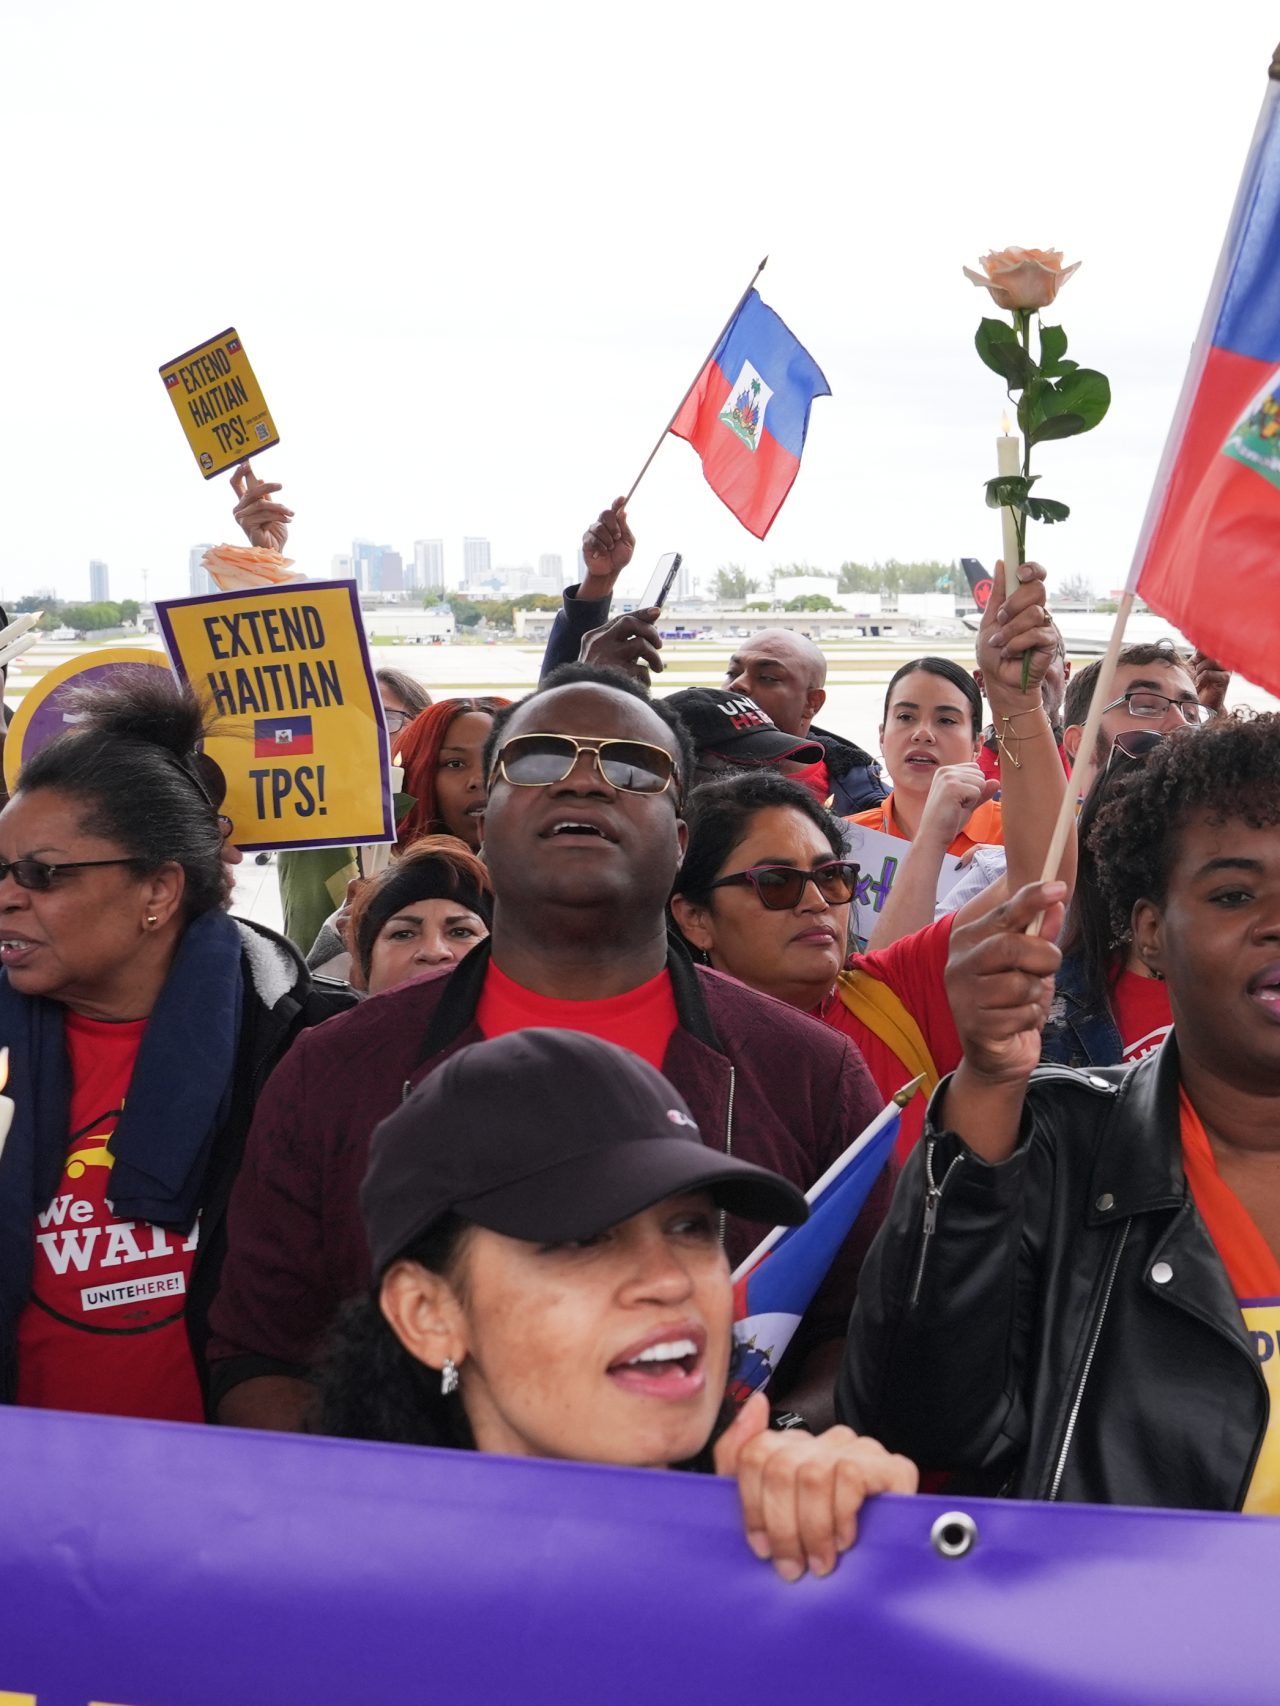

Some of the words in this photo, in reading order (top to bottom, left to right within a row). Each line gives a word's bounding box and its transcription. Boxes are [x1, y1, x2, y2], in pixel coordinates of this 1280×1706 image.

[178, 348, 231, 395] EXTEND
[188, 375, 249, 428] HAITIAN
[211, 415, 250, 453] TPS!
[203, 605, 326, 660] EXTEND
[206, 660, 345, 716] HAITIAN
[249, 765, 327, 820] TPS!
[38, 1194, 94, 1228] We
[87, 1278, 180, 1305] UNITEHERE!
